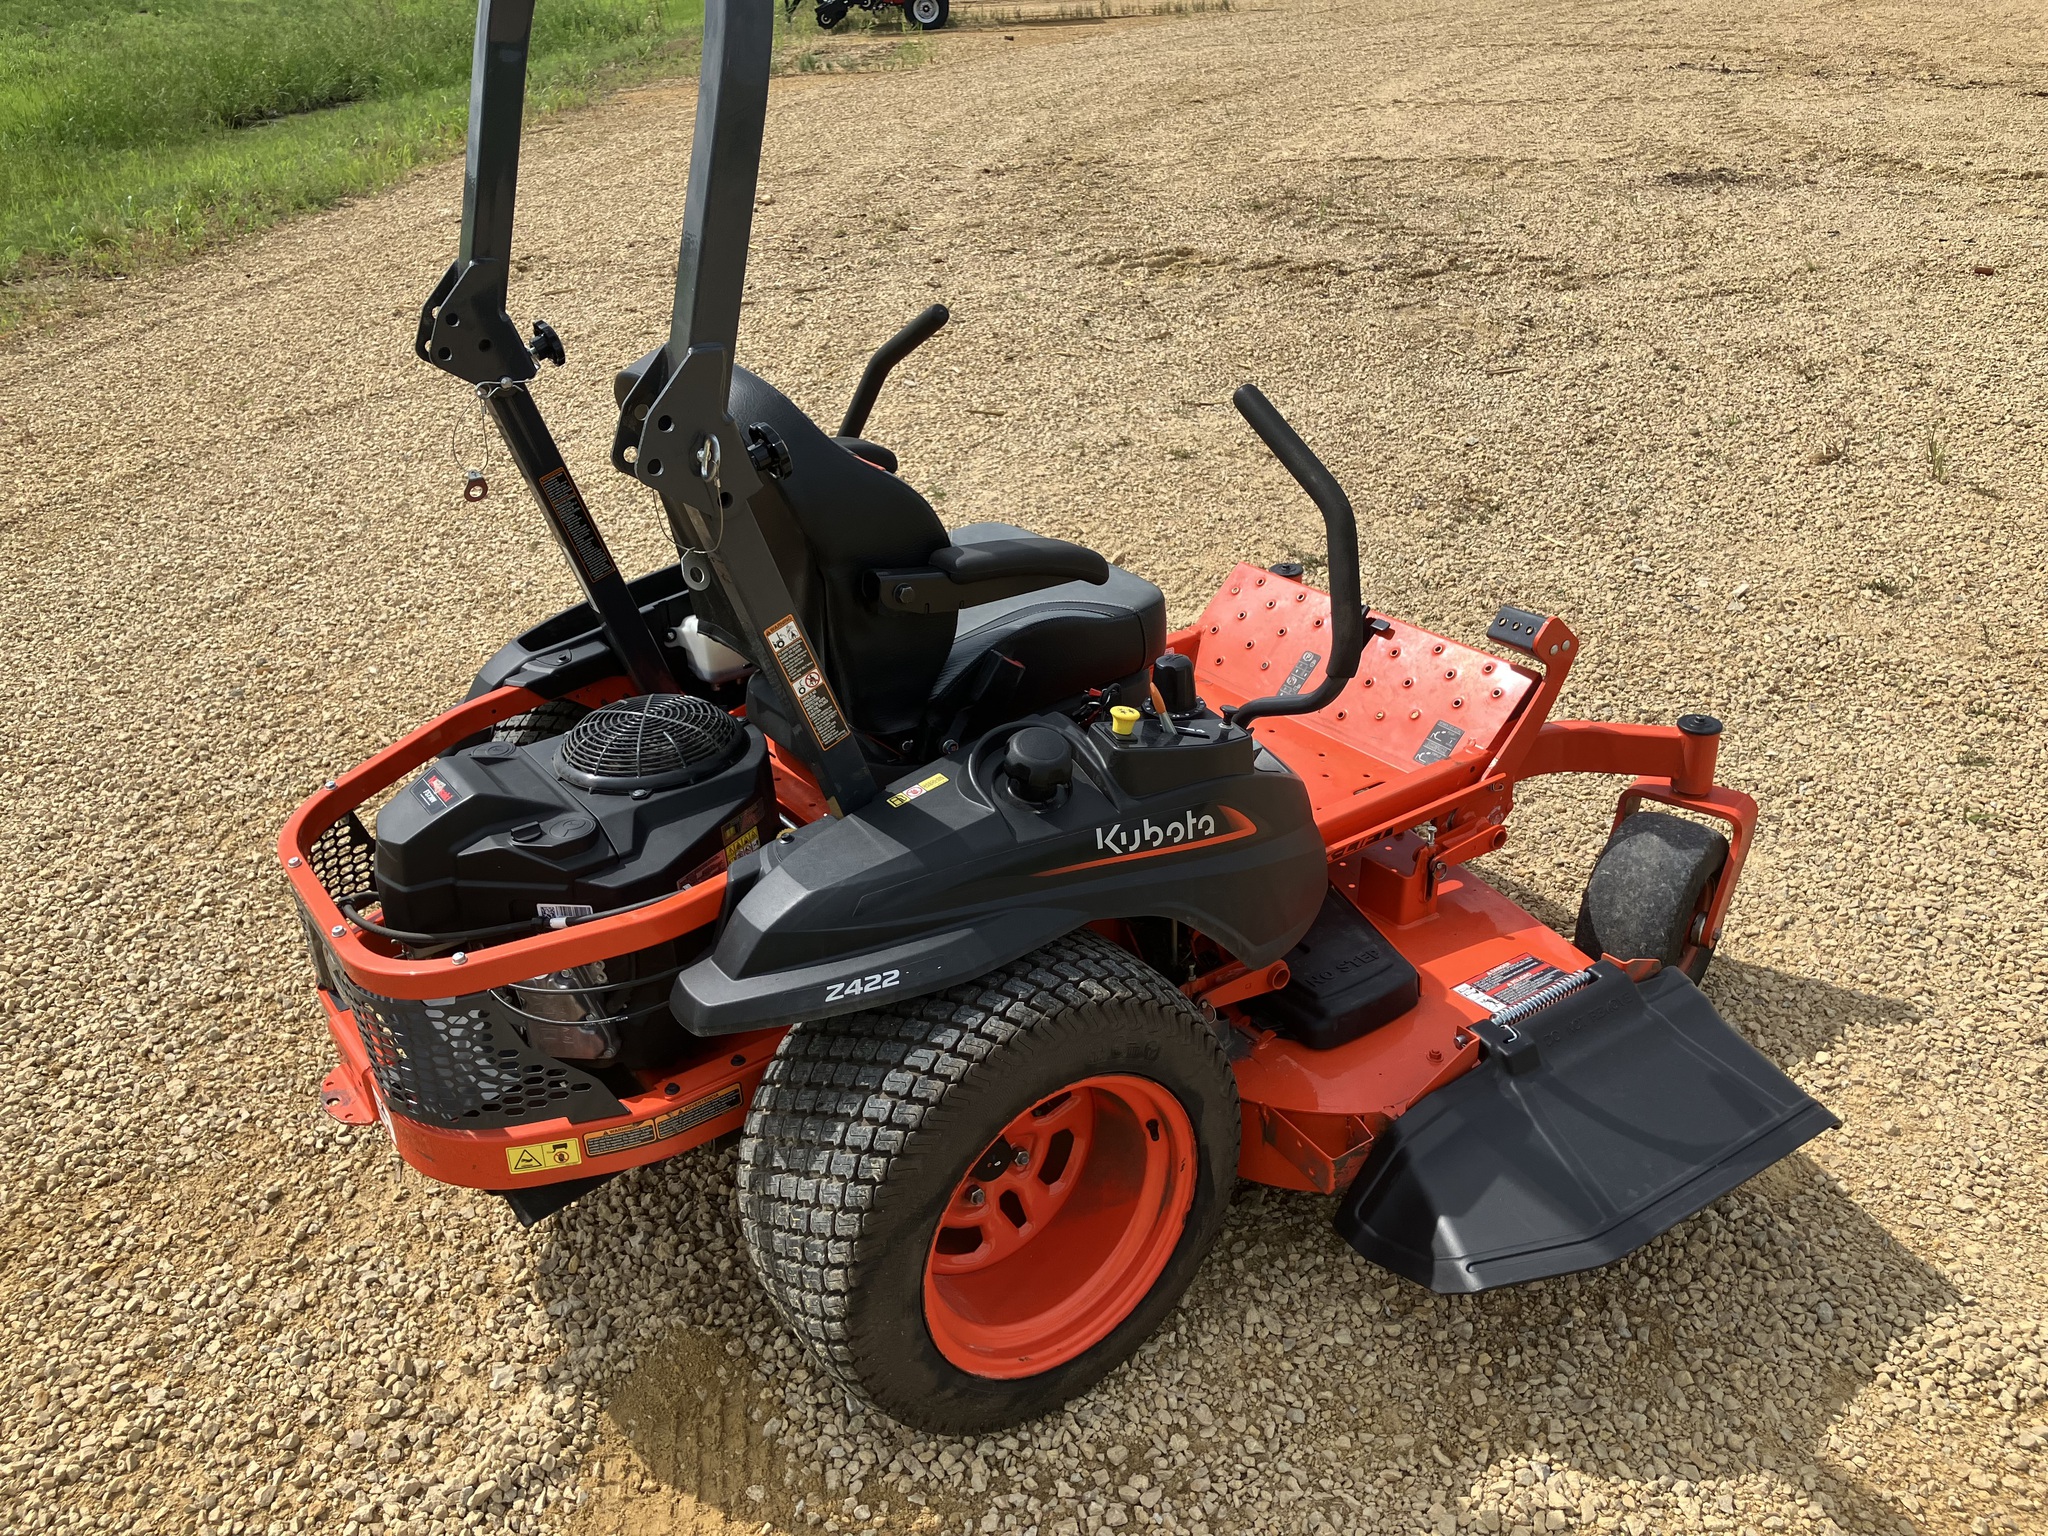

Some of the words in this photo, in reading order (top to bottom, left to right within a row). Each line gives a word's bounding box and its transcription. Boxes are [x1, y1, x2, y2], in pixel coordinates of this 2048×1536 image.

[427, 775, 453, 803] Ksaki
[1096, 809, 1215, 855] Kubota
[825, 969, 900, 1003] Z422
[1305, 971, 1335, 988] NO
[1336, 950, 1380, 973] STEP
